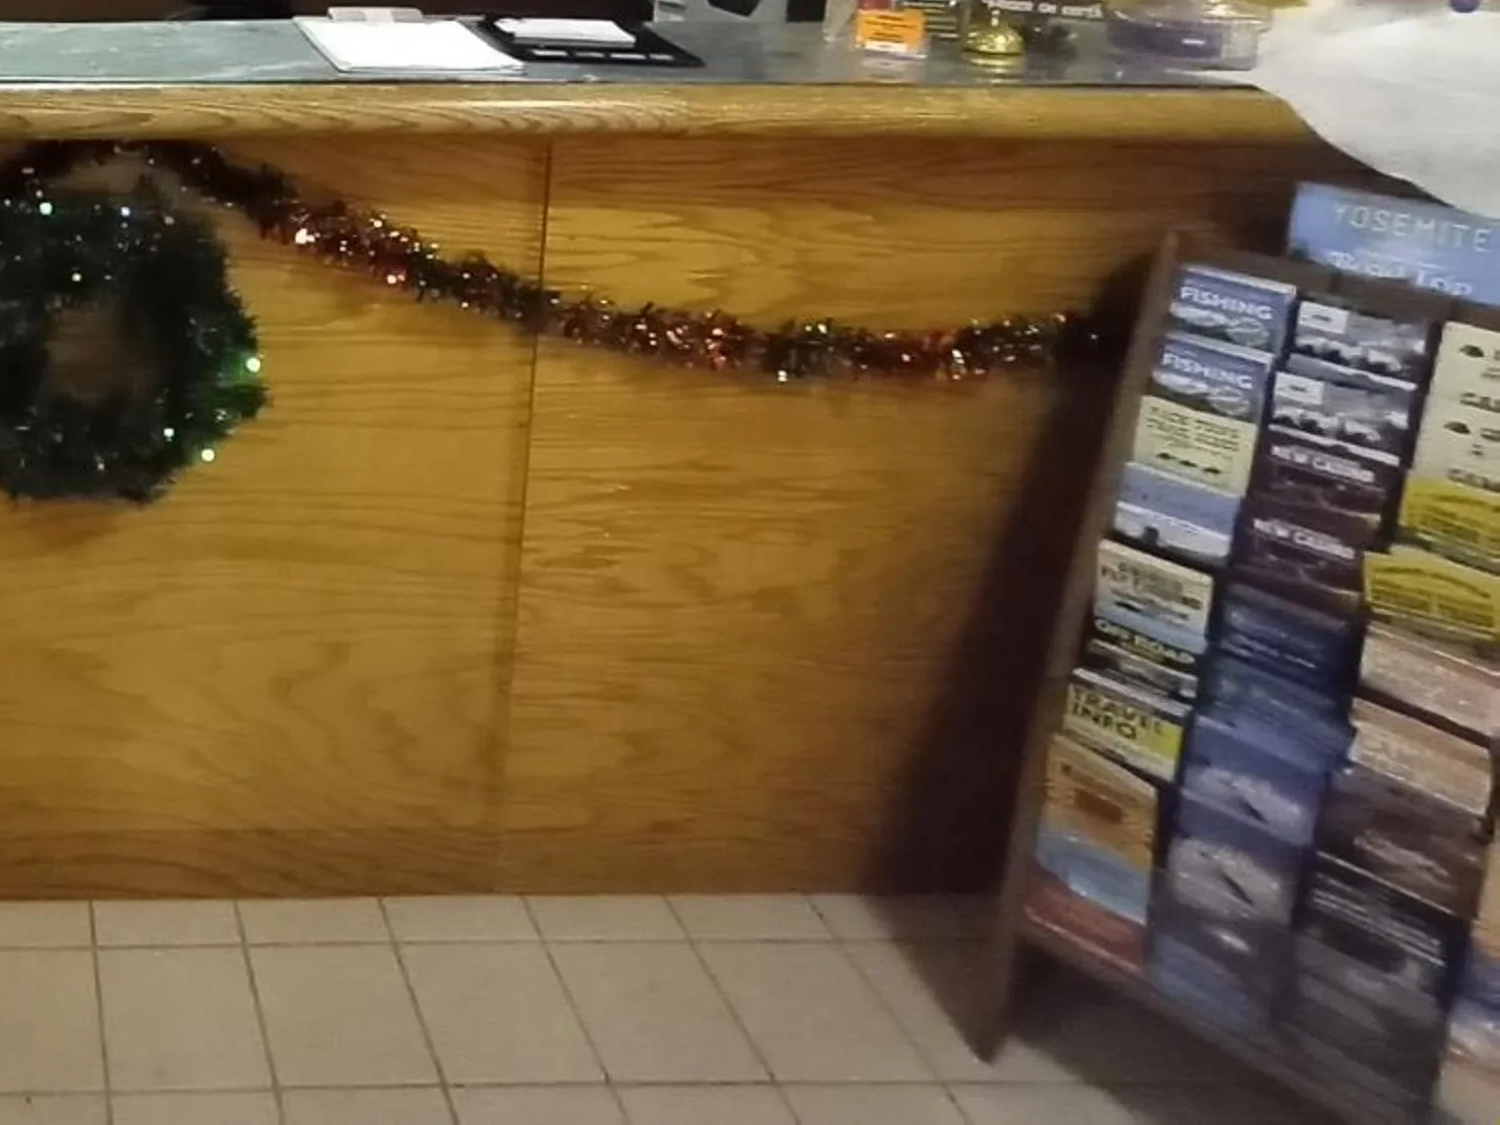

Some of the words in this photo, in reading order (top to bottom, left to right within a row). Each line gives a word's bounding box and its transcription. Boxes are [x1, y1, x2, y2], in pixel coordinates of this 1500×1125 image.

[1334, 203, 1493, 254] YOSEMITE
[1180, 286, 1273, 321] FISHING
[1162, 352, 1254, 391] FISHING
